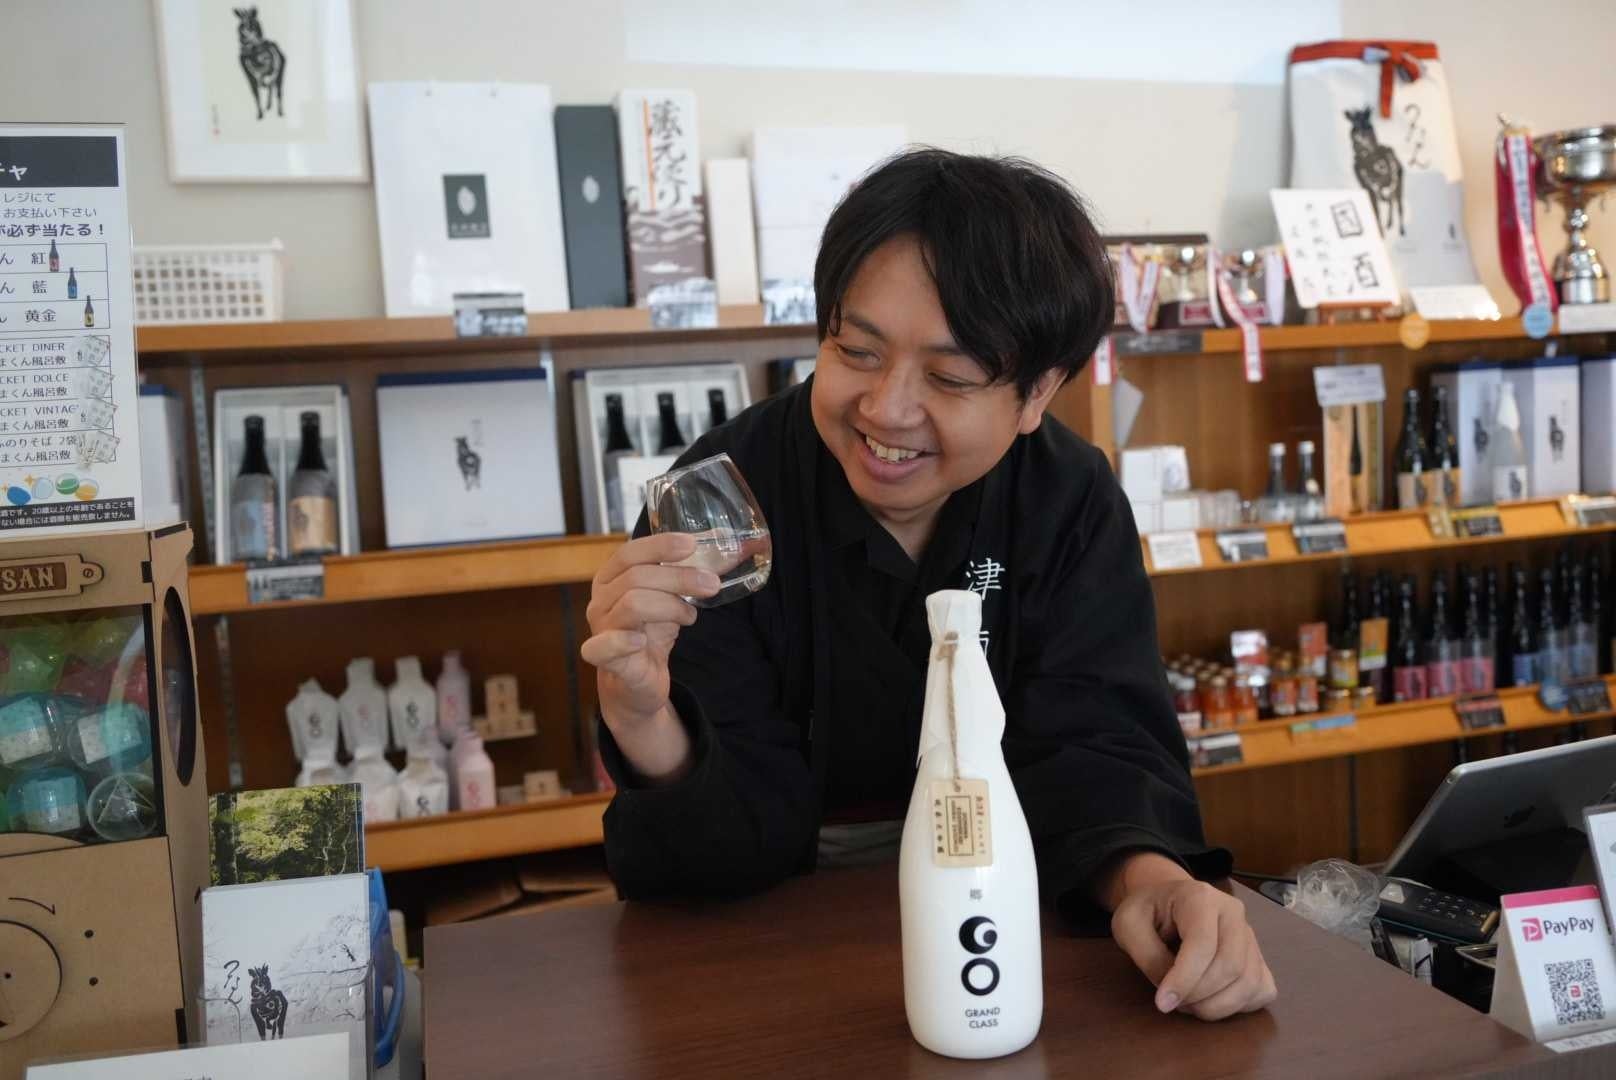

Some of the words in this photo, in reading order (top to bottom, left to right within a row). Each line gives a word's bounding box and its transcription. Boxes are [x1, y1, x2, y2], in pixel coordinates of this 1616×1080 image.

[4, 191, 56, 203] レジにて
[4, 207, 97, 219] お支払い下さい
[31, 252, 47, 265] 紅
[0, 281, 15, 295] ん
[32, 280, 48, 294] 藍
[25, 308, 57, 323] 黄金
[32, 342, 65, 352] DINER
[33, 373, 69, 383] DOLCE
[3, 565, 56, 592] SAN
[1543, 917, 1596, 936] PayPay
[965, 1008, 1000, 1019] GRAND
[969, 1019, 999, 1030] CLASS
